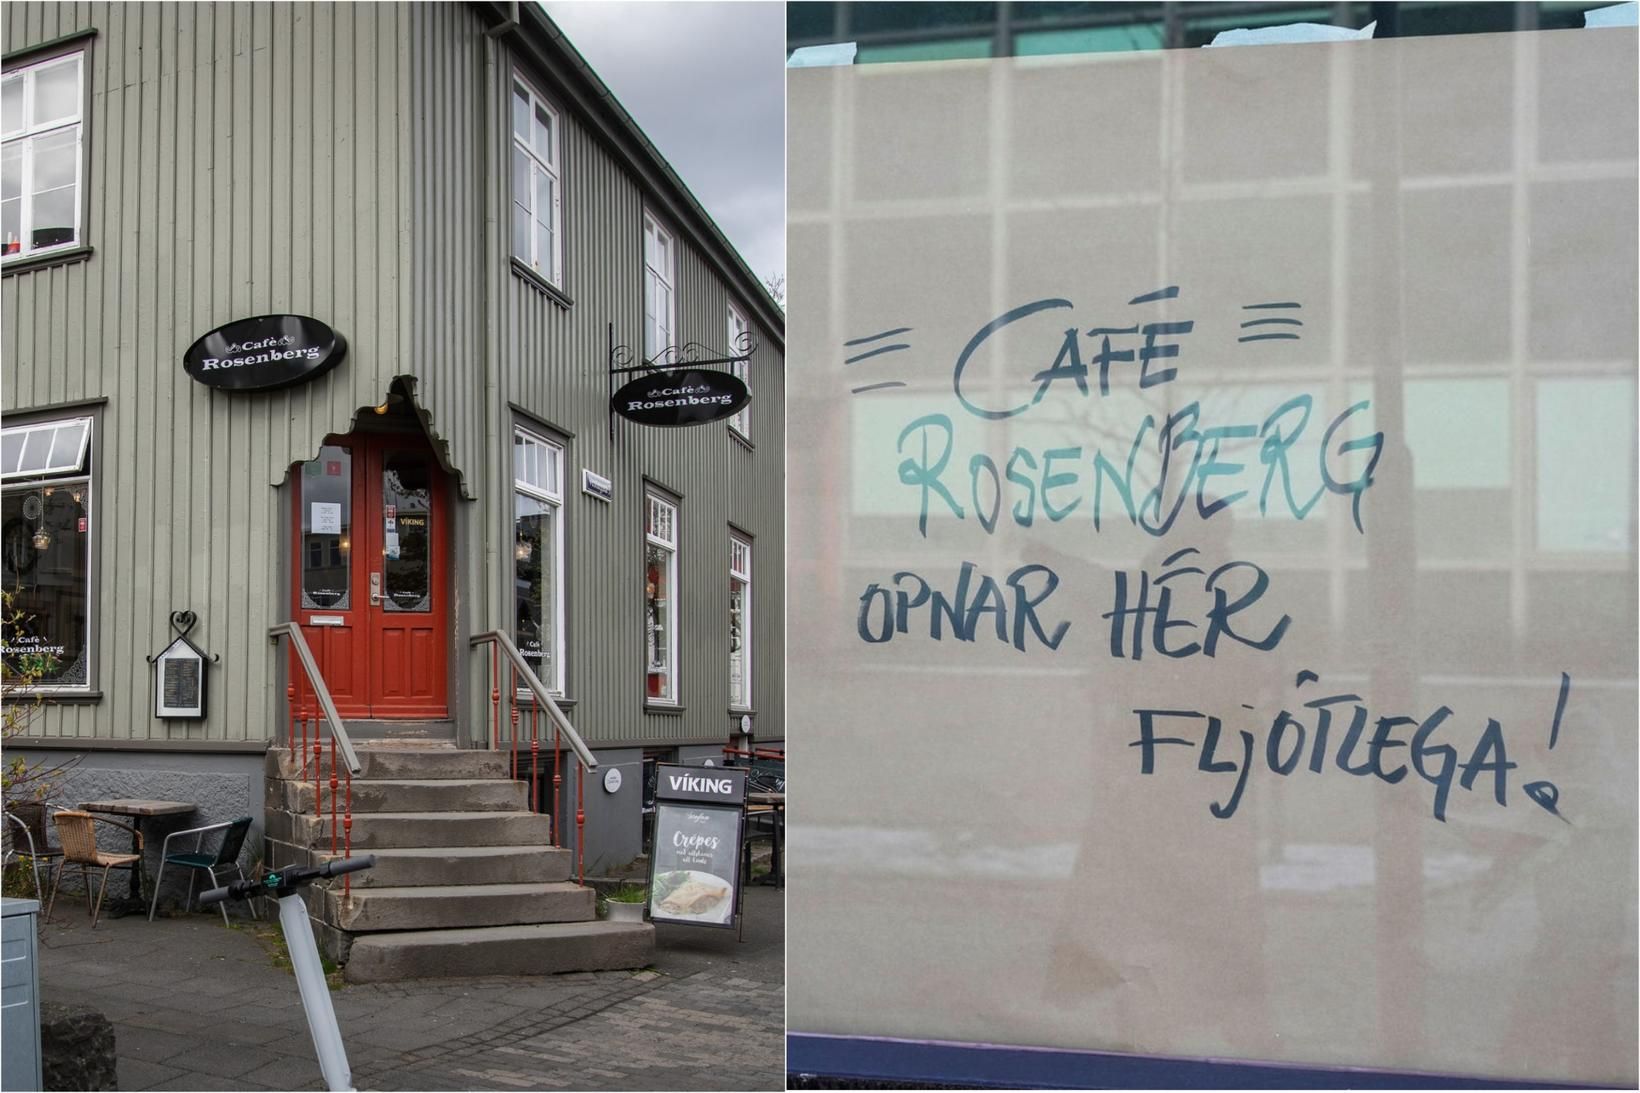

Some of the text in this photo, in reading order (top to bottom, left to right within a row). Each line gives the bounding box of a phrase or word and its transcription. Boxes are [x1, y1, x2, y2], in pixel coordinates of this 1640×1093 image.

[202, 346, 320, 371] Rosenberg
[953, 286, 1194, 420] CAFÉ
[627, 394, 733, 411] Rosenberg
[897, 394, 1384, 539] ROSENBERG
[857, 548, 1292, 661] OPNAR HÉR
[669, 773, 732, 794] VÍKING
